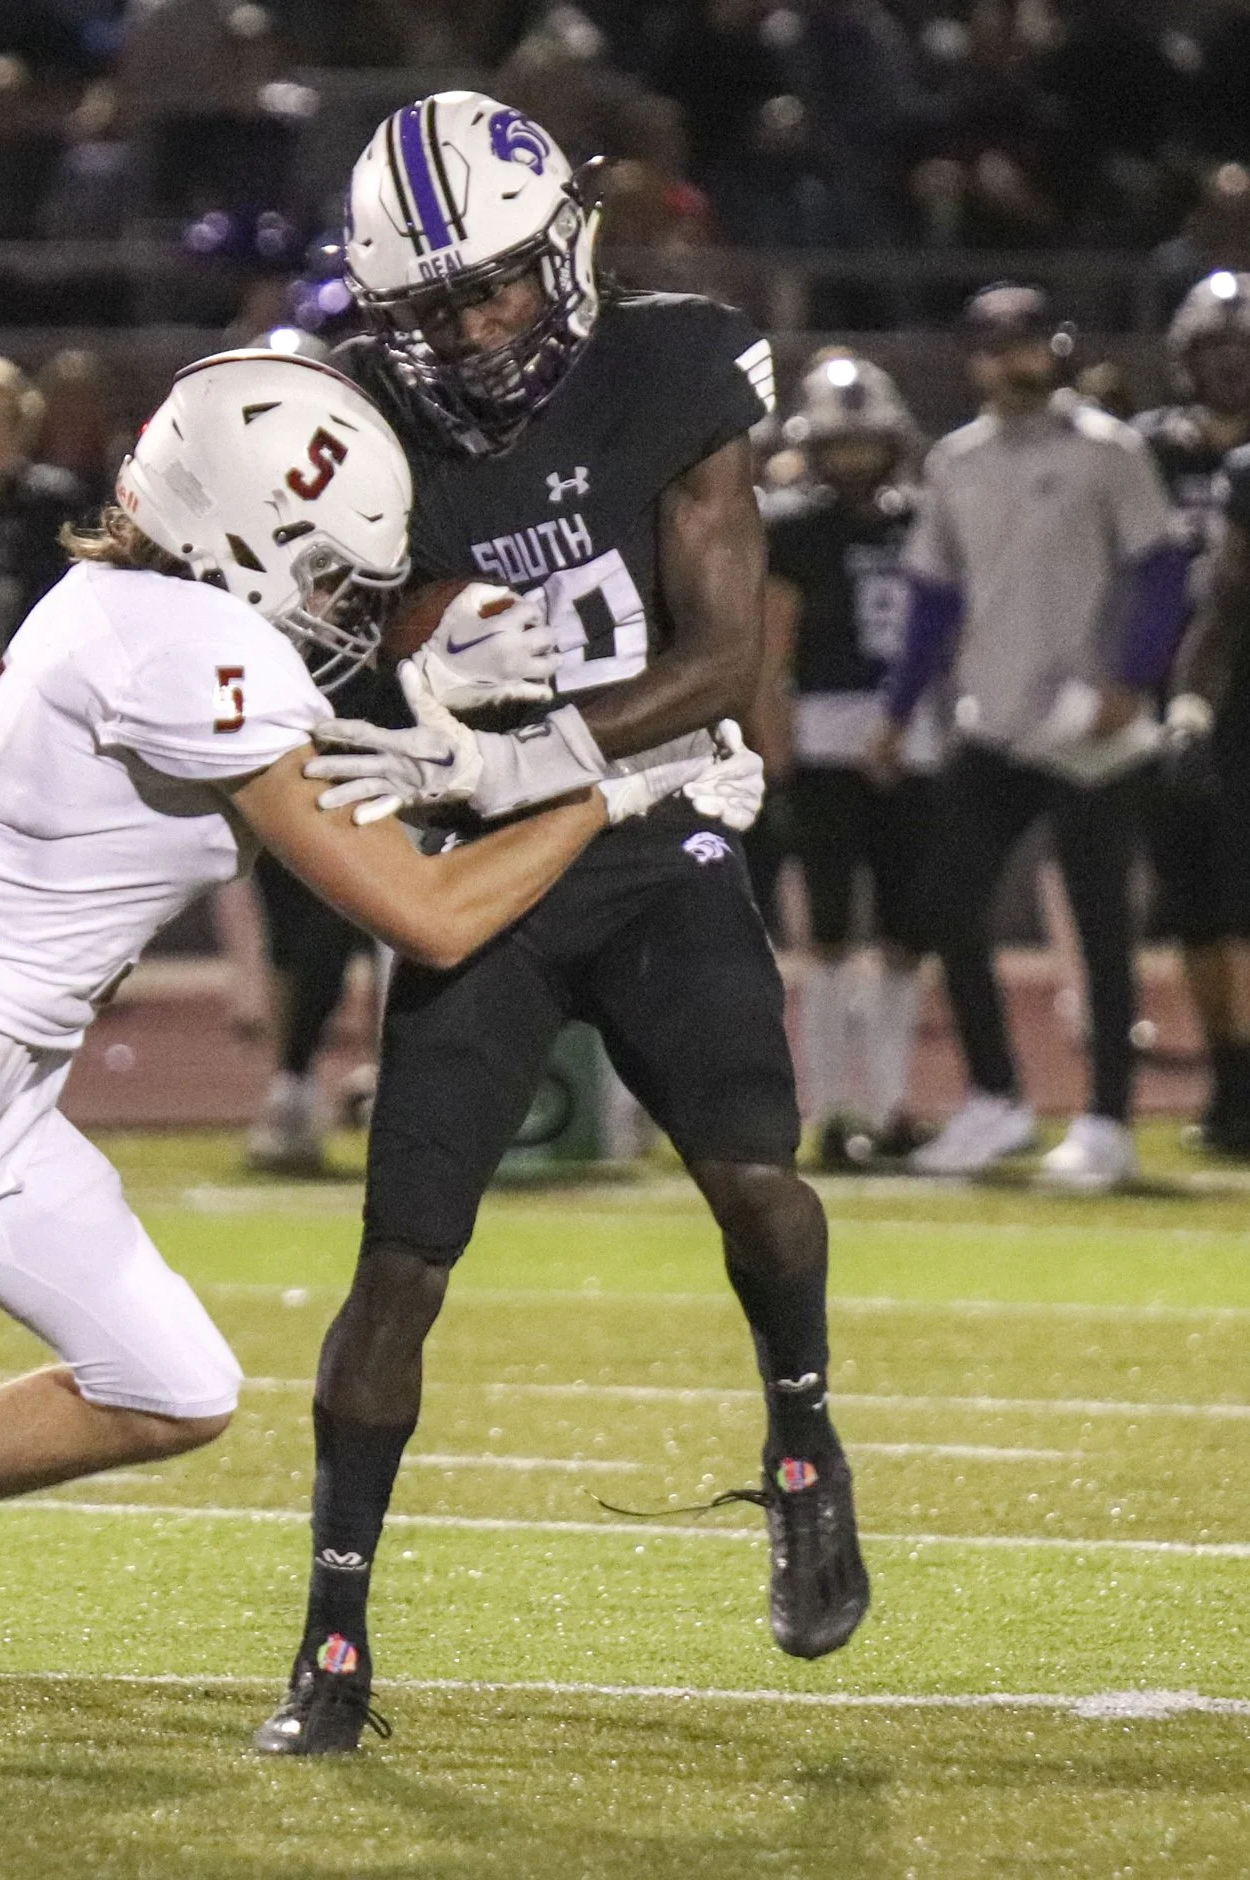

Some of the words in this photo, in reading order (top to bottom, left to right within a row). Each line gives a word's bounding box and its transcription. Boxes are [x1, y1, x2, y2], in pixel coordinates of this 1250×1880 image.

[285, 426, 349, 502] 5
[470, 513, 593, 584] SOUTH
[213, 664, 246, 735] 5
